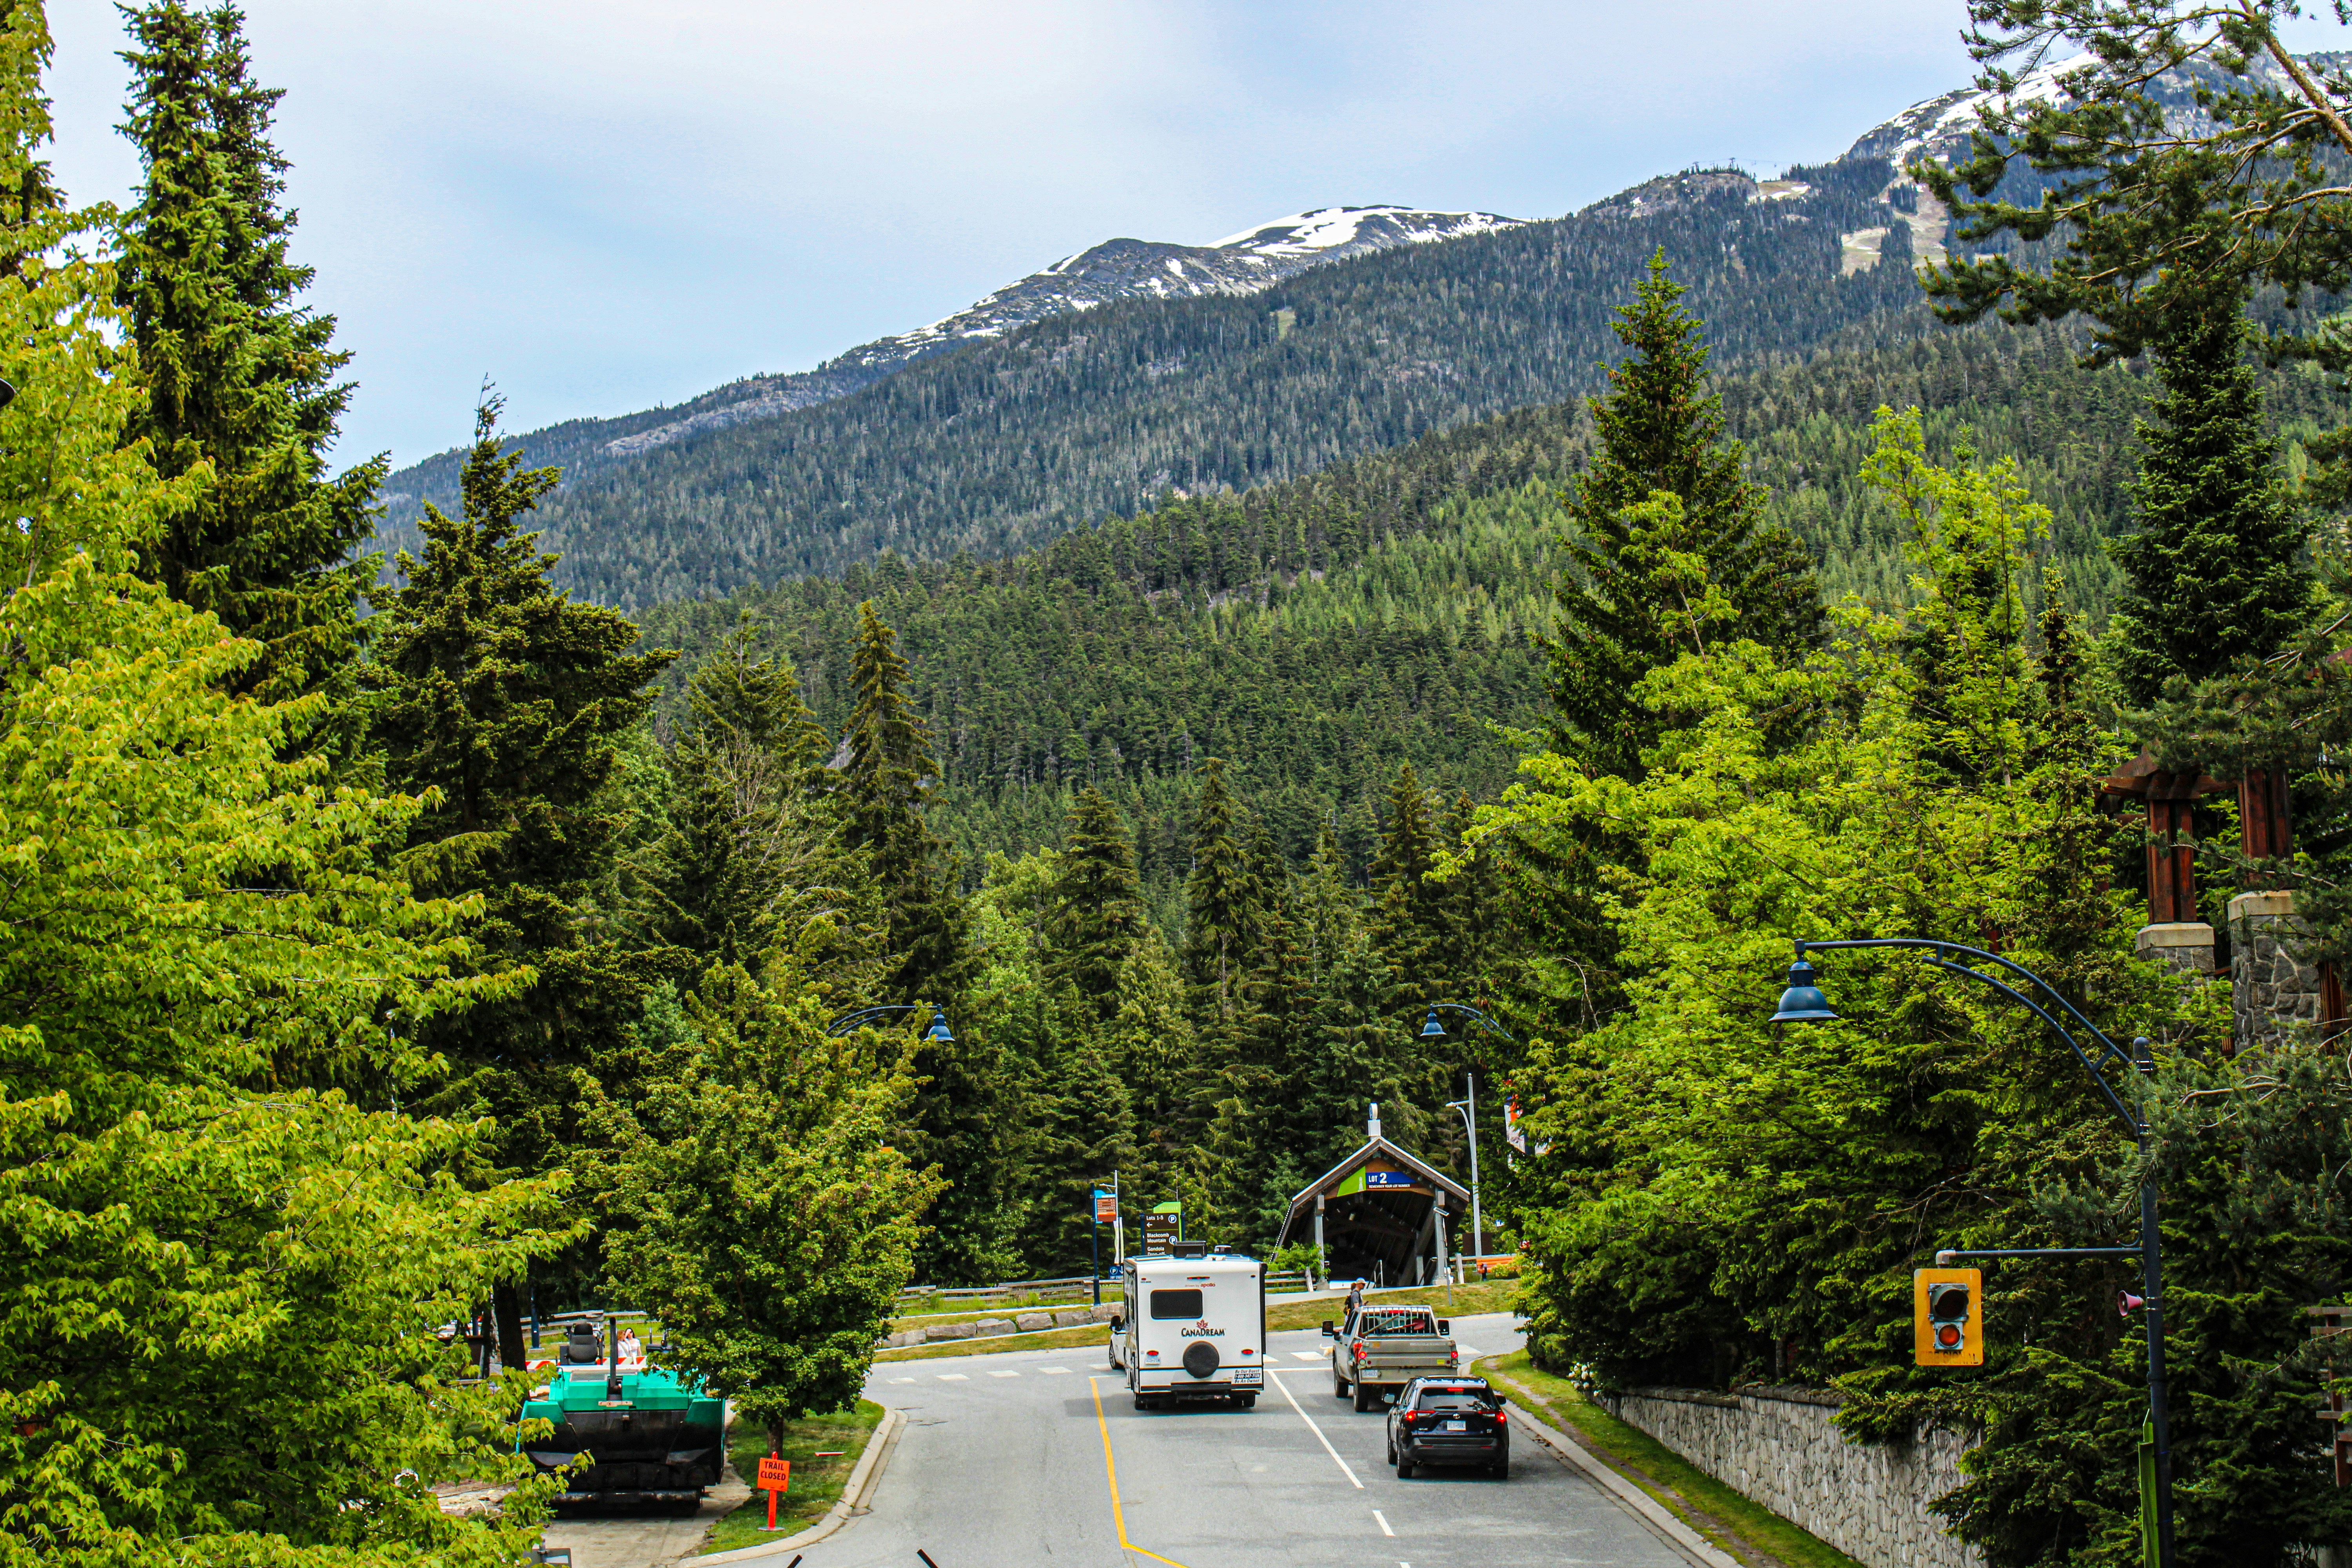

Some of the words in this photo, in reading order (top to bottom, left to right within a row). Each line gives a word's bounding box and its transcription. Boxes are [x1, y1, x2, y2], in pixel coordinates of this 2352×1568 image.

[1379, 1172, 1387, 1184] 2
[765, 1461, 784, 1470] TRAIL
[760, 1471, 786, 1481] CLOSED
